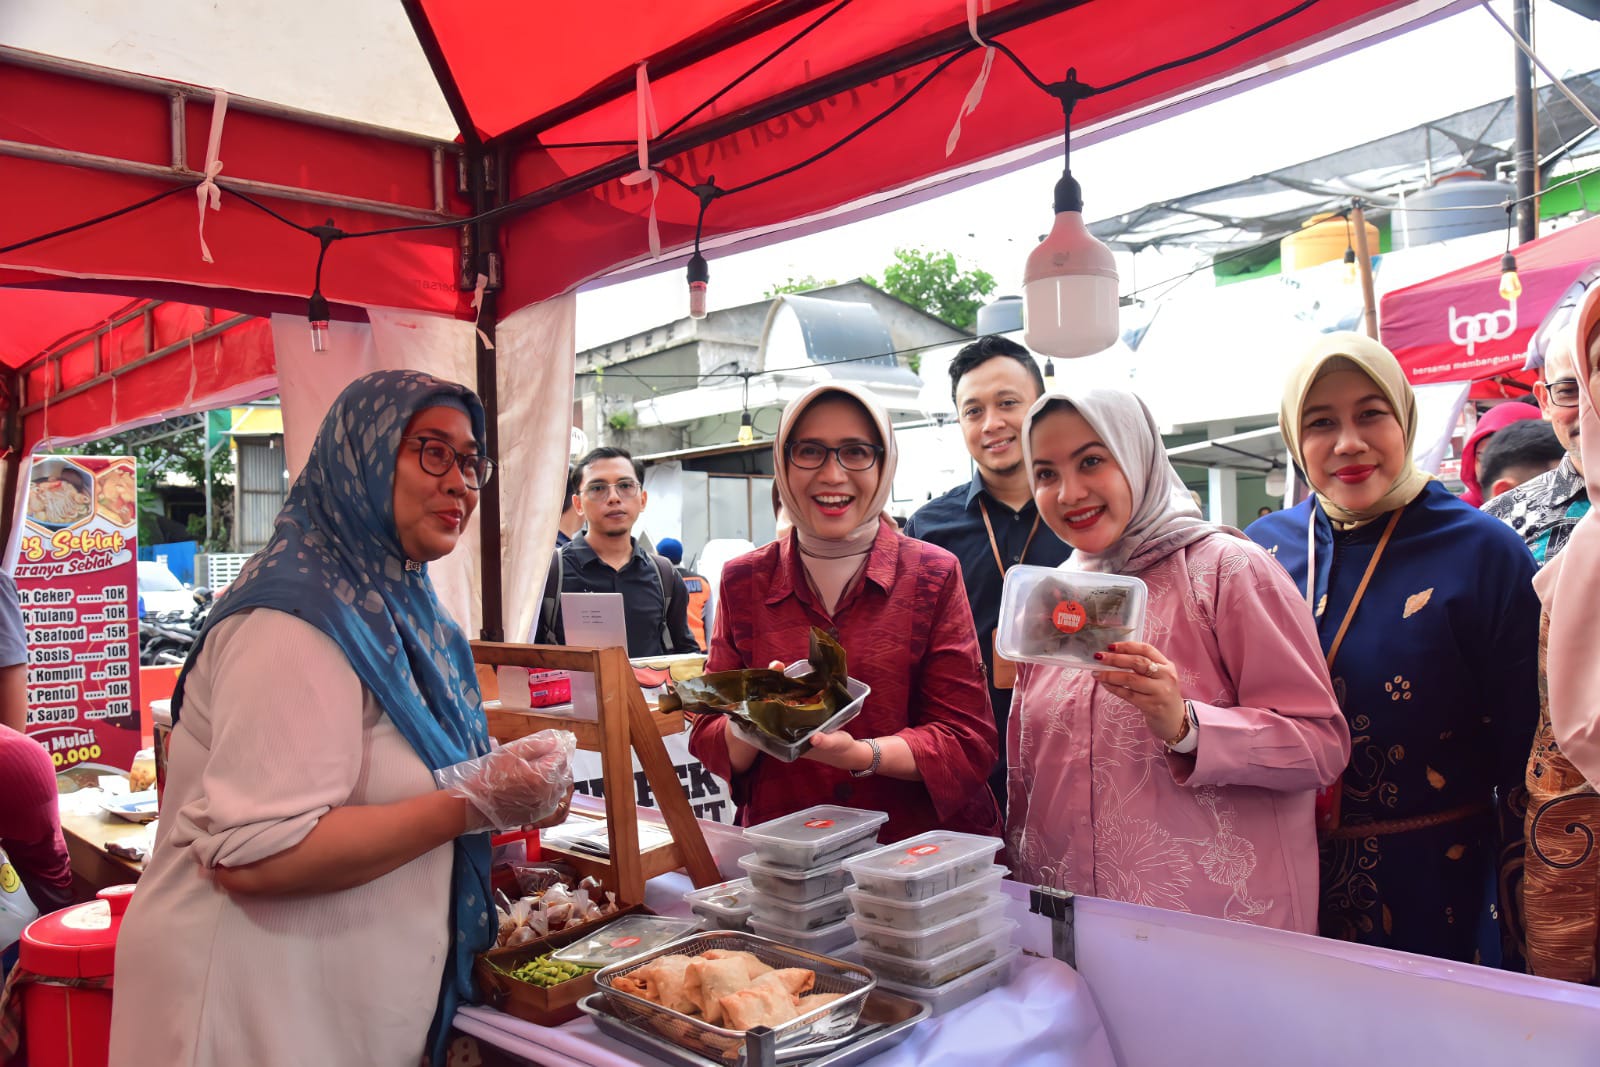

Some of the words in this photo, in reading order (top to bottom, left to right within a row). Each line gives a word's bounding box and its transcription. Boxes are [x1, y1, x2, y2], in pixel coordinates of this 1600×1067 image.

[1412, 364, 1450, 375] bersama
[1453, 355, 1509, 370] membangun
[52, 530, 124, 557] Seblak
[68, 554, 113, 573] Seblak
[34, 591, 71, 602] Ceker
[105, 588, 125, 599] 10K
[35, 611, 74, 622] Tulang
[106, 607, 126, 618] 10K
[35, 629, 84, 642] Seafood
[106, 626, 126, 638] 15K
[36, 650, 70, 661] Sosis
[107, 645, 127, 657] 10K
[37, 667, 83, 681] Komplit
[107, 664, 127, 676] 15K
[37, 688, 76, 700] Pentol
[108, 683, 128, 695] 10K
[38, 707, 75, 720] Sayap
[108, 702, 129, 714] 10K
[52, 730, 95, 751] Mulai
